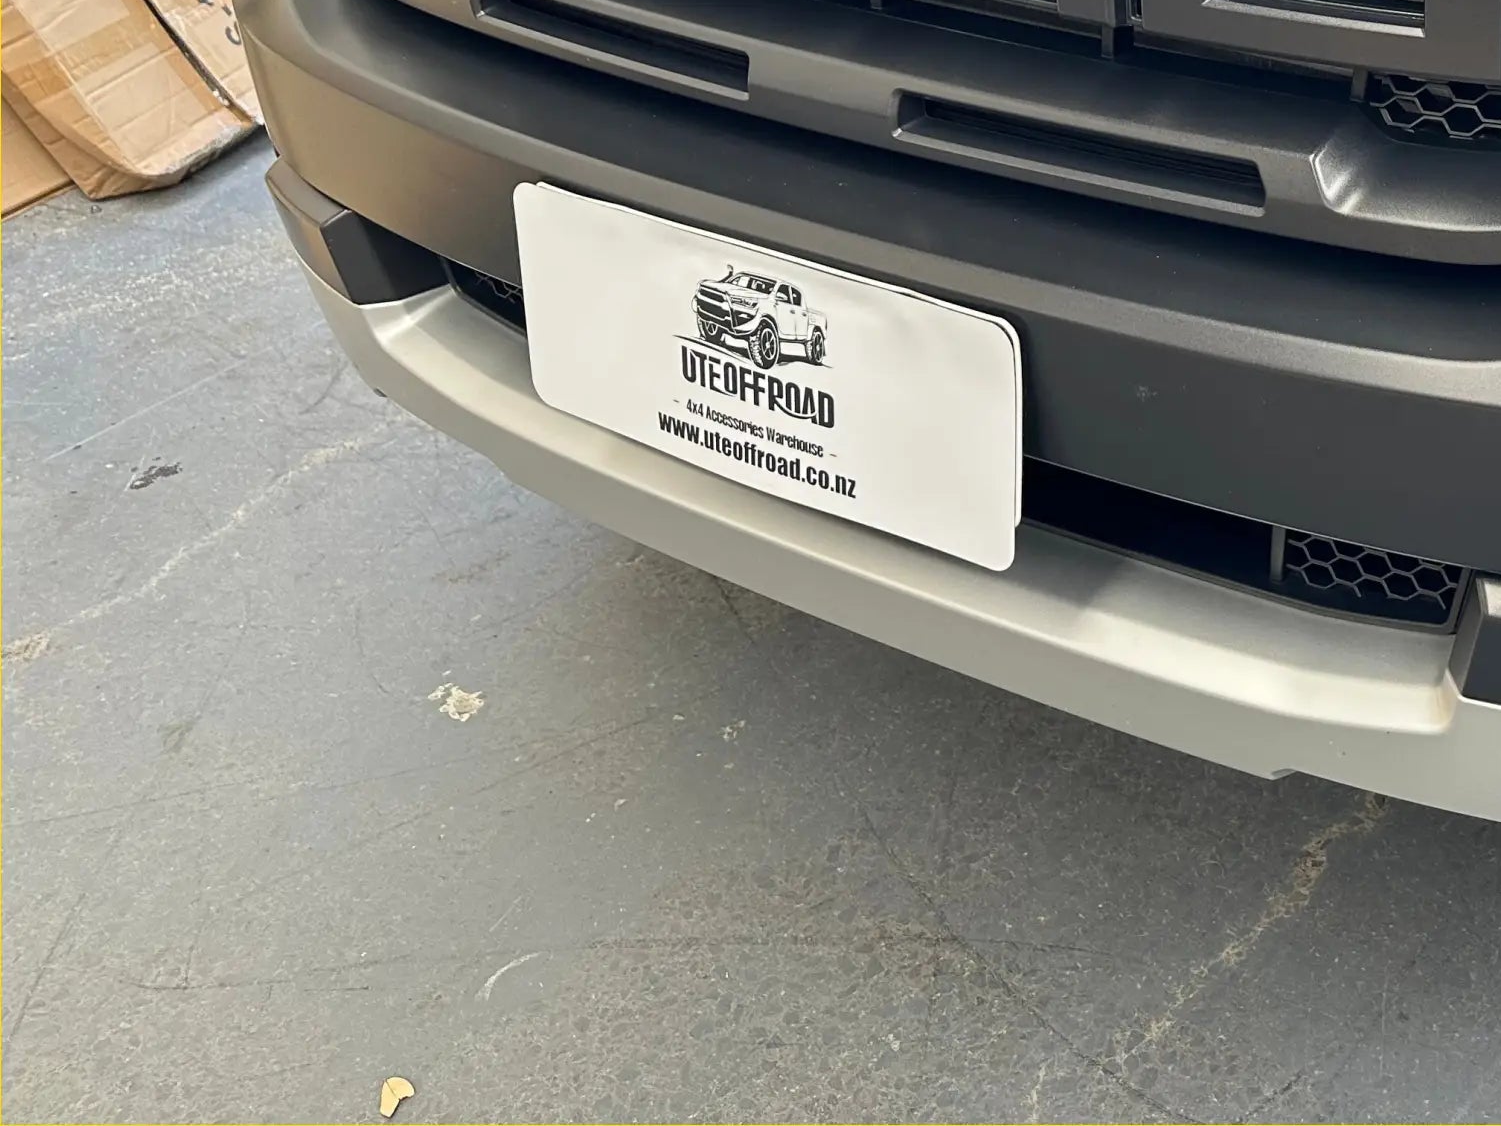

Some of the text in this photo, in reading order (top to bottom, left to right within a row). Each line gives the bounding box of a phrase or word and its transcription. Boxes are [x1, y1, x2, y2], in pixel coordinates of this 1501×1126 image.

[681, 345, 835, 429] UTEOFFROAD
[686, 398, 824, 458] 4x4 Accessories Warehouse
[658, 411, 856, 499] www.uteoffroad.co.nz
